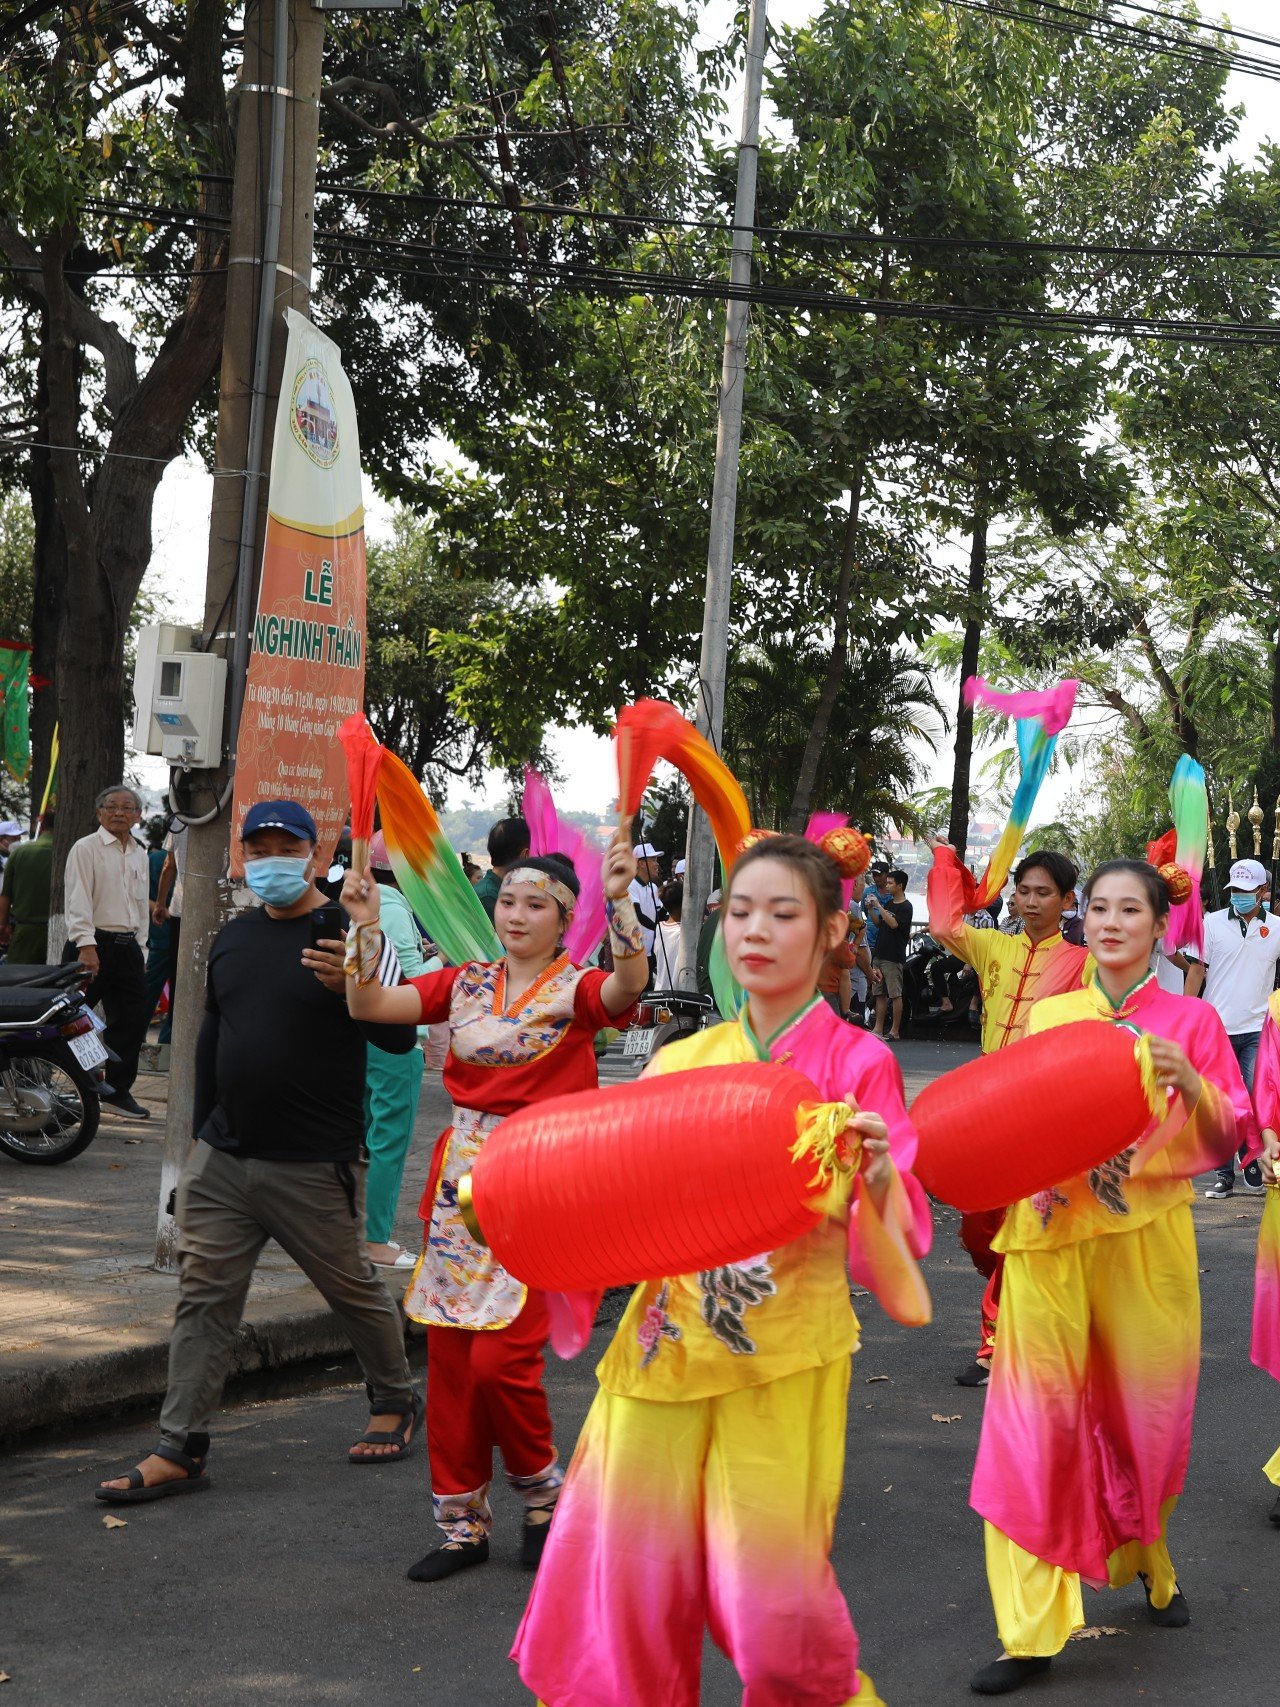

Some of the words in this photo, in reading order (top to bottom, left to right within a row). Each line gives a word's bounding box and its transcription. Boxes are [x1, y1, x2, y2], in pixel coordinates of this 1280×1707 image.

[304, 560, 334, 607] LỄ
[252, 613, 325, 664] NGHINH
[326, 614, 362, 669] THẦN
[248, 684, 256, 702] Từ
[257, 685, 280, 709] 08g30
[281, 685, 293, 707] đến
[315, 693, 329, 716] ngày
[277, 712, 284, 730] 10
